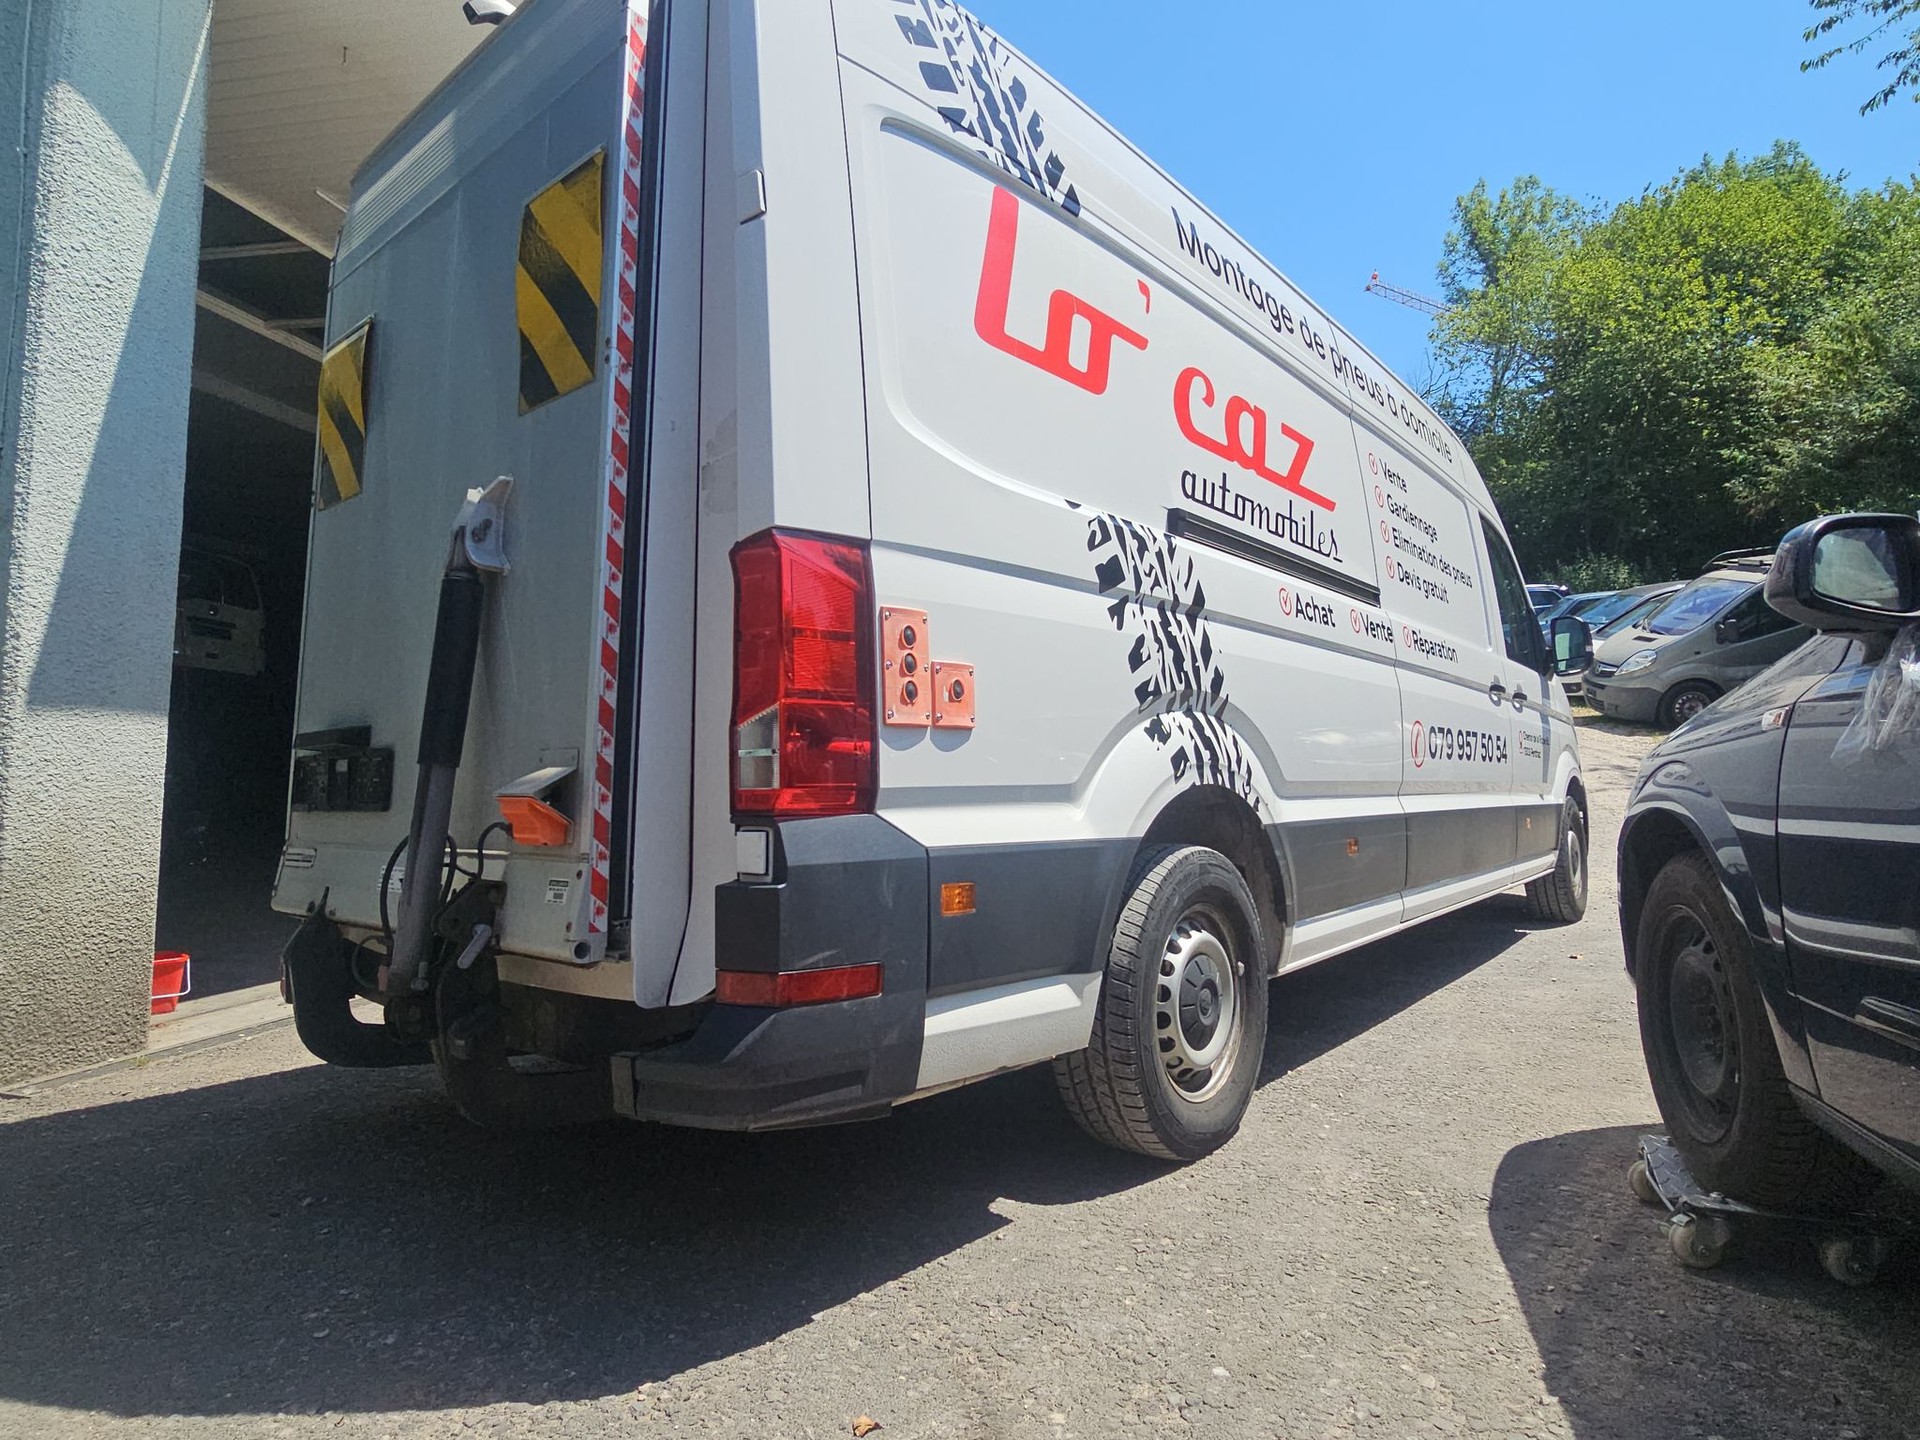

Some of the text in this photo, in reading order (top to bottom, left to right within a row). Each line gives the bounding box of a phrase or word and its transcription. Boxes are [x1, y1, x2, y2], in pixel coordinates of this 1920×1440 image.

[1171, 205, 1453, 464] Montage de pneus à domicile
[1379, 458, 1408, 493] Vente
[1180, 469, 1344, 563] automobiles
[1386, 493, 1438, 543] Gardiennage
[1396, 561, 1450, 604] Devis gratuit
[1439, 554, 1453, 578] des
[1452, 566, 1473, 589] pneus
[1295, 592, 1459, 664] Achat Vente Réparation
[1428, 725, 1454, 761] 079
[1456, 729, 1479, 762] 957
[1480, 732, 1494, 763] 50
[1496, 735, 1508, 764] 54
